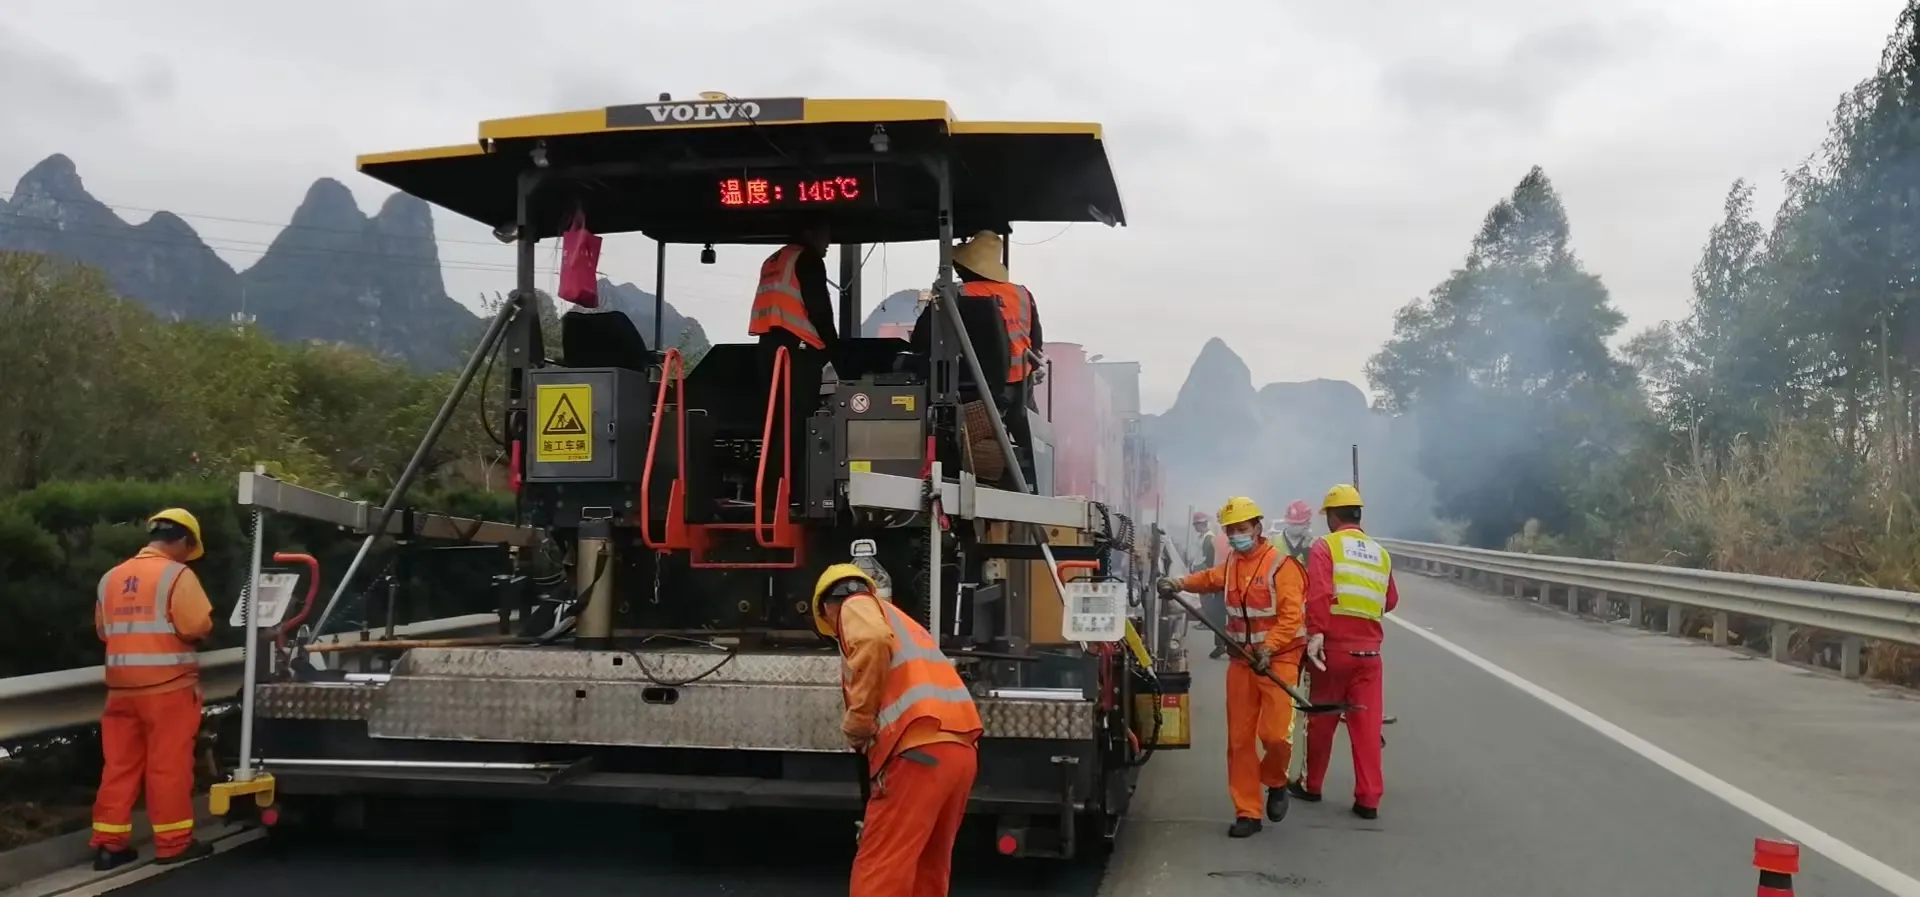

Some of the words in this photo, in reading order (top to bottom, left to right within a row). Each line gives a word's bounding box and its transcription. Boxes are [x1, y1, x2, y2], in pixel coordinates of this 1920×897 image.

[646, 101, 760, 122] VOLVO
[543, 439, 586, 451] 施工车辆
